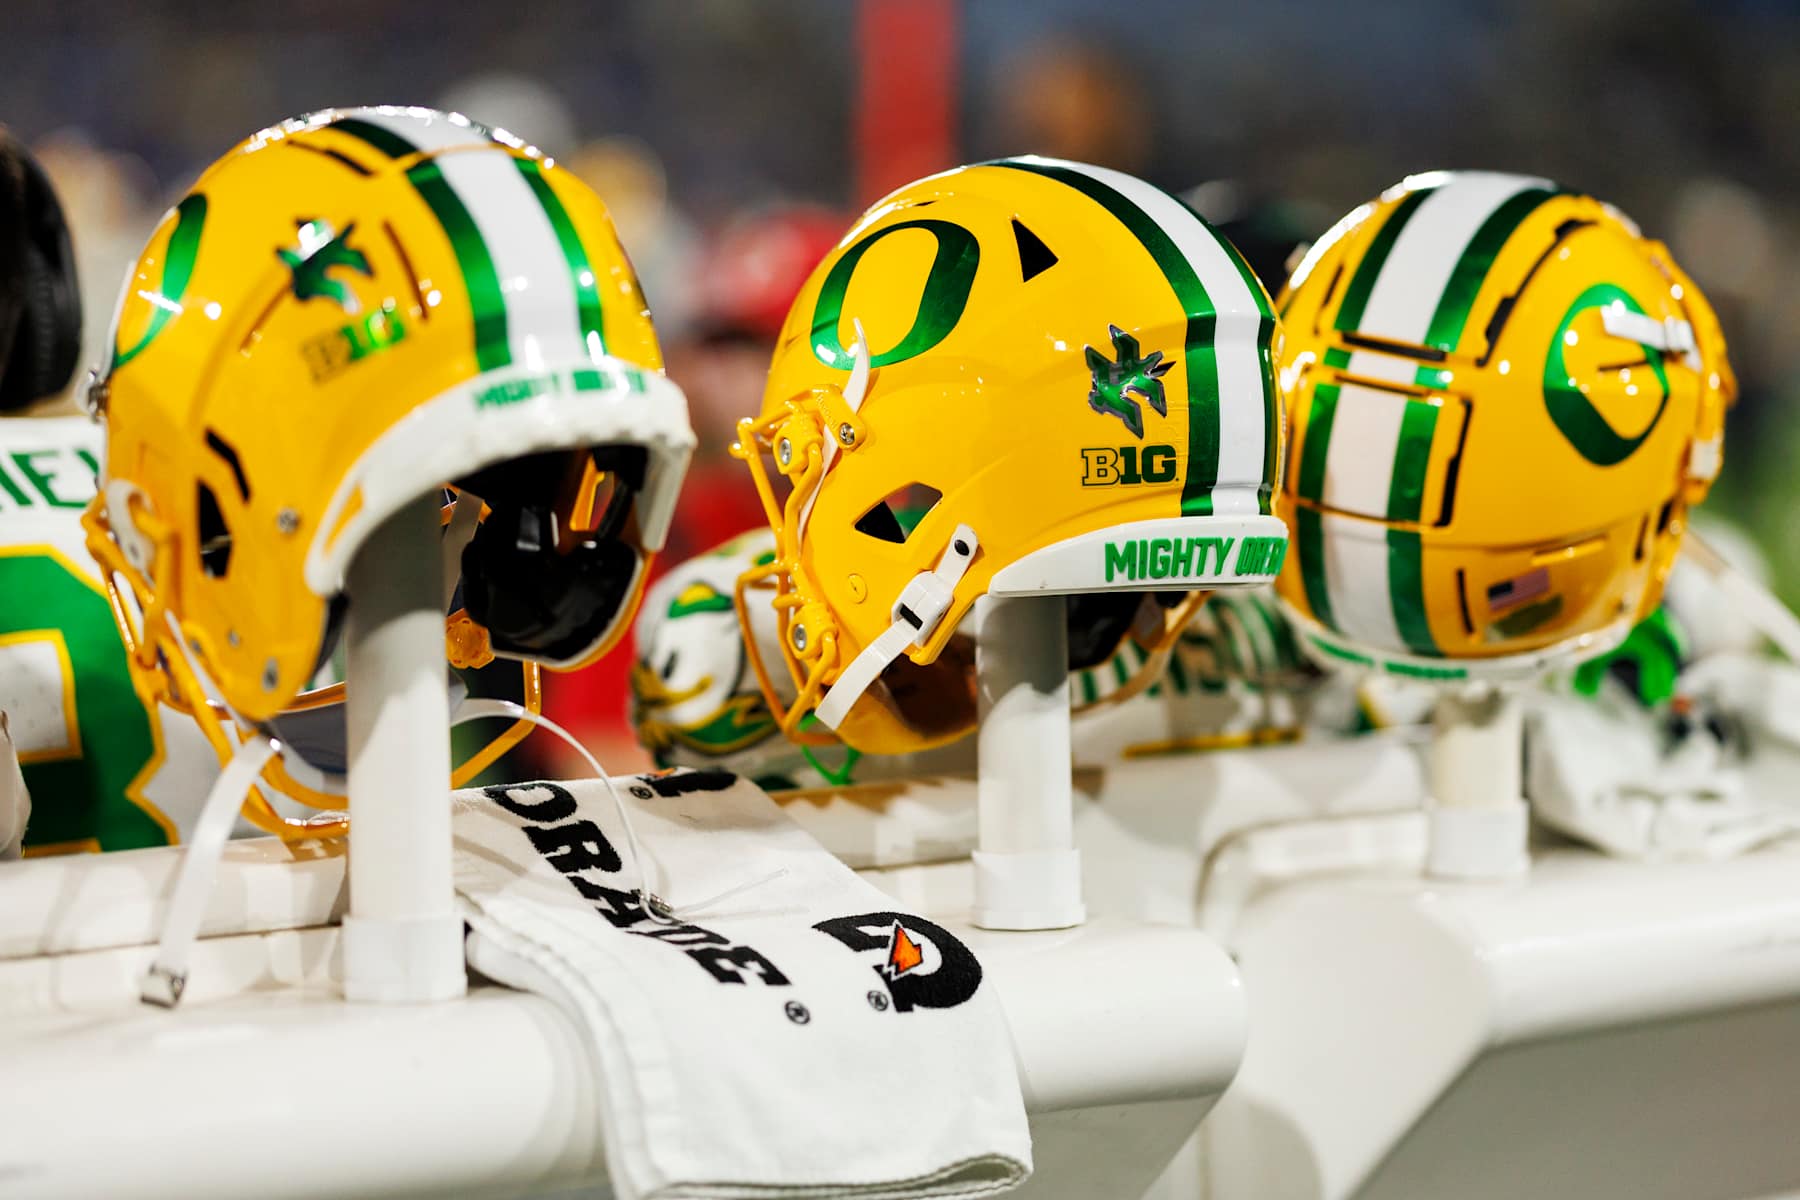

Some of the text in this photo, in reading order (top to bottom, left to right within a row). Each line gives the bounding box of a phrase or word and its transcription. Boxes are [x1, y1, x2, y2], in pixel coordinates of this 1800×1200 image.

[810, 219, 980, 371] O
[1542, 282, 1671, 467] O
[1105, 537, 1235, 582] MIGHTY
